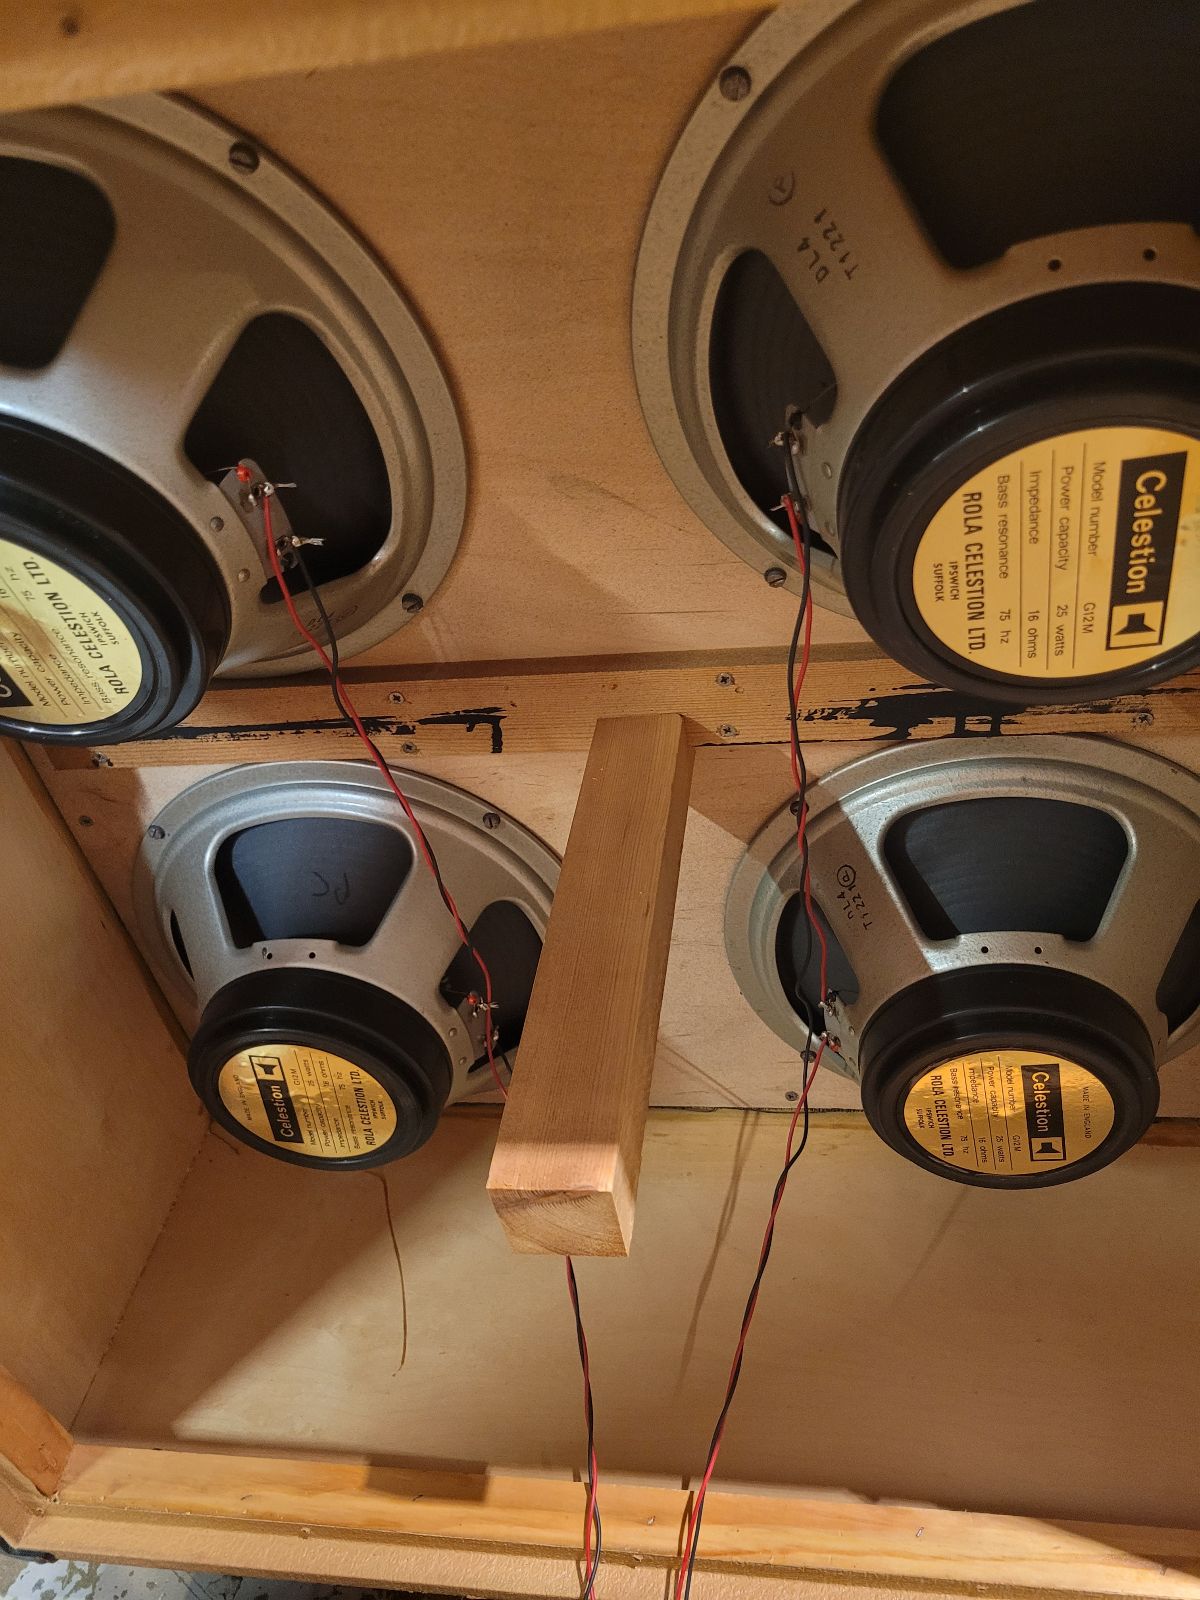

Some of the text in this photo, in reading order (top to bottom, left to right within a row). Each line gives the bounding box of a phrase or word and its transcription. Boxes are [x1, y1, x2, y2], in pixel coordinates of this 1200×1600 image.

[1081, 461, 1106, 634] Model number G12M
[1126, 469, 1168, 594] Celestion
[963, 492, 985, 655] ROLA CELESTION LTD.
[997, 475, 1010, 643] Bass resonance 75 hz
[1027, 470, 1042, 659] Impedance 16 ohms
[1054, 465, 1074, 656] Power capacity 25 watts
[21, 590, 36, 601] 75
[933, 563, 944, 602] SUFFOLK
[950, 561, 959, 601] IPSWICH
[23, 557, 130, 695] ROLA CELESTION LTD.
[79, 612, 108, 646] IPSWICH
[91, 611, 119, 645] SUFFOLK
[11, 632, 70, 706] Power capacity
[52, 628, 94, 678] resonance
[25, 680, 51, 706] Model
[49, 654, 92, 705] Impedance
[92, 682, 112, 704] Bass
[289, 1068, 300, 1086] G12M
[930, 1075, 944, 1096] ROLA
[950, 1068, 958, 1084] Bass
[987, 1066, 995, 1087] Power
[270, 1085, 294, 1137] Celestion
[354, 1086, 371, 1125] CELESTION
[369, 1099, 378, 1119] IPSWICH
[926, 1108, 935, 1129] IPSWICH
[934, 1100, 952, 1140] CELESTION
[1032, 1072, 1052, 1132] Celestion
[322, 1129, 330, 1147] Power
[363, 1128, 376, 1146] ROLA
